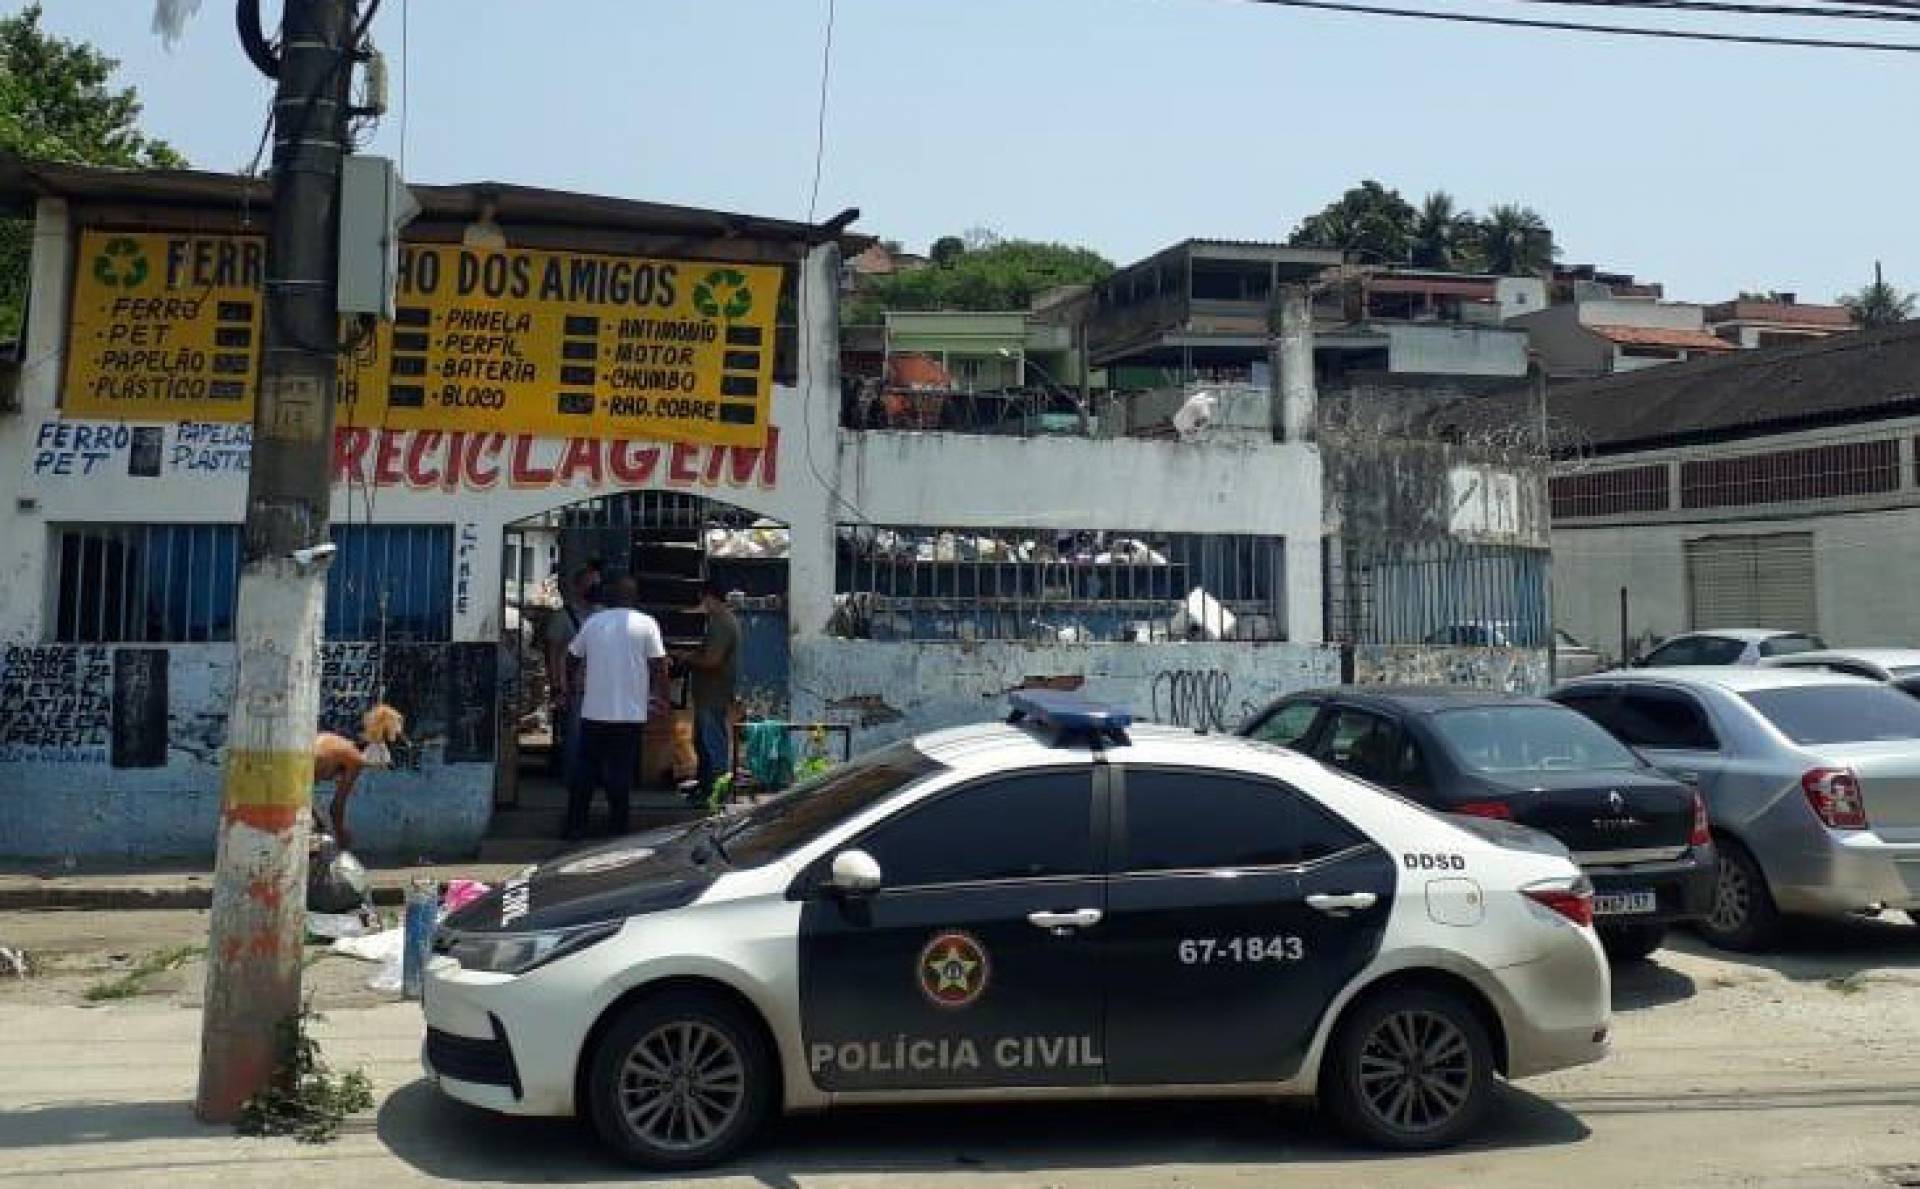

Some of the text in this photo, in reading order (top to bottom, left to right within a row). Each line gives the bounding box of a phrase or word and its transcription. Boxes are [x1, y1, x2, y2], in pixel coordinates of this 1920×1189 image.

[167, 239, 264, 288] FERR
[458, 251, 530, 299] DOS
[540, 256, 677, 307] AMIGOS
[111, 298, 199, 320] FERRO
[445, 308, 532, 333] PANELA
[110, 324, 169, 345] PET
[444, 333, 522, 356] PERFIL
[100, 348, 205, 373] PAPELÃO
[615, 343, 695, 366] MOTOR
[611, 369, 695, 393] CHUMBO
[441, 384, 506, 410] BLOCO
[37, 423, 128, 451] FERRO
[33, 451, 111, 475] PET
[334, 426, 780, 491] RECICLAGEM
[1403, 853, 1465, 871] DDSD
[1179, 936, 1304, 964] 67-1843
[810, 1034, 1103, 1073] POLÍCIA CIVIL
